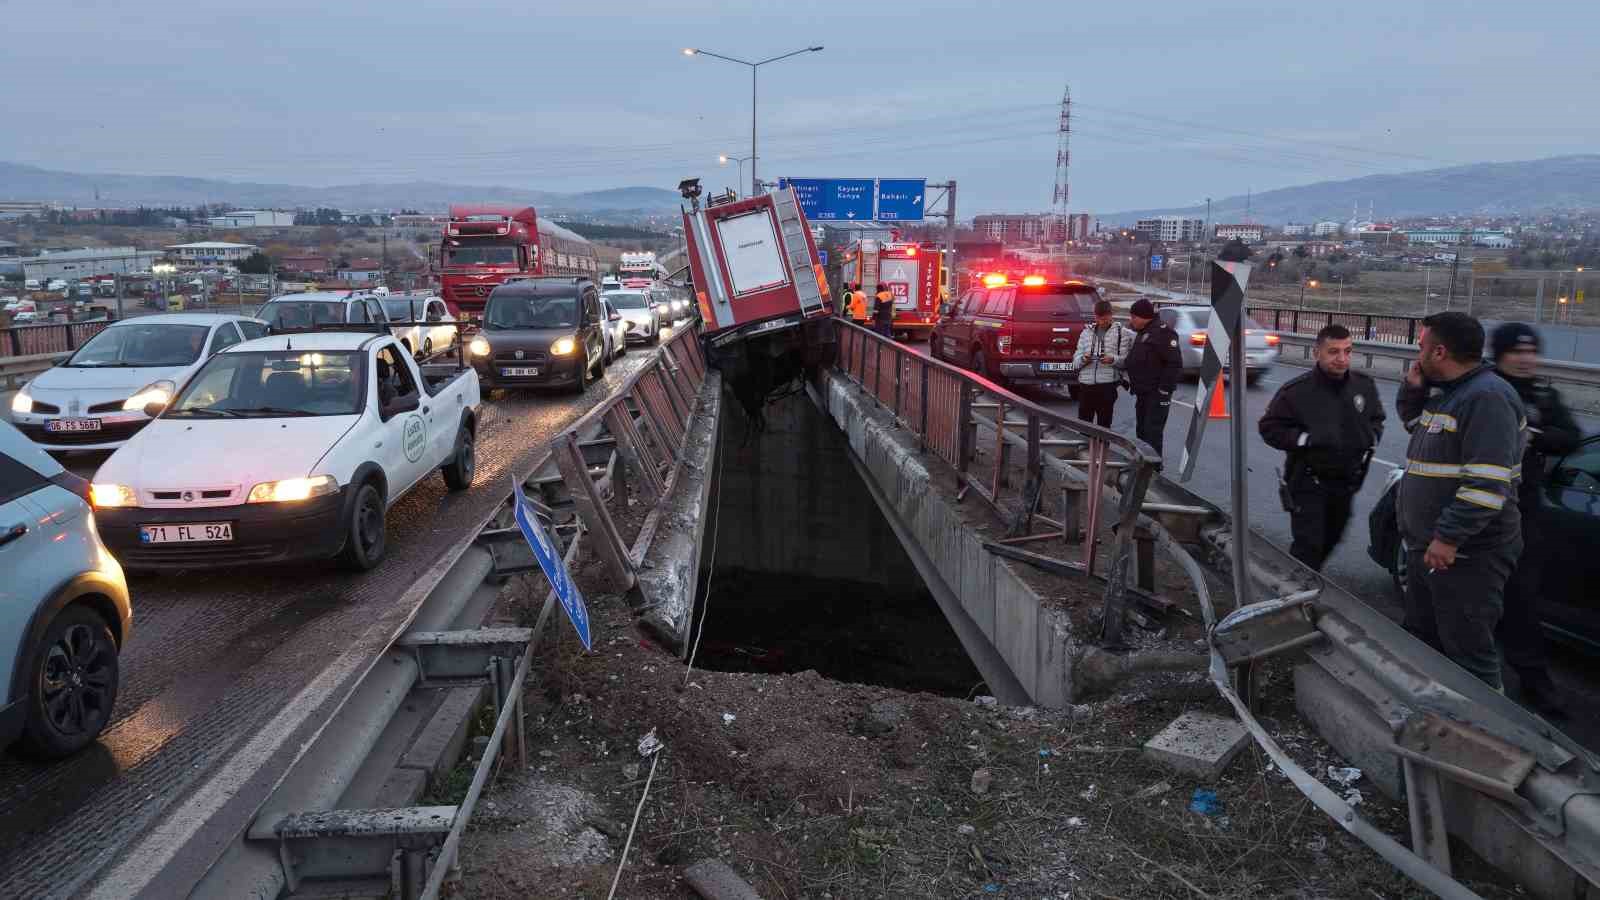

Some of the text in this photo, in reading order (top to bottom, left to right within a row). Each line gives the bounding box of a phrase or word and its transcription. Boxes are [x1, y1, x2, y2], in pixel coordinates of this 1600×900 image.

[890, 284, 907, 296] 112
[51, 422, 61, 431] 06
[65, 421, 77, 430] FS
[150, 525, 231, 542] 71 FL 524
